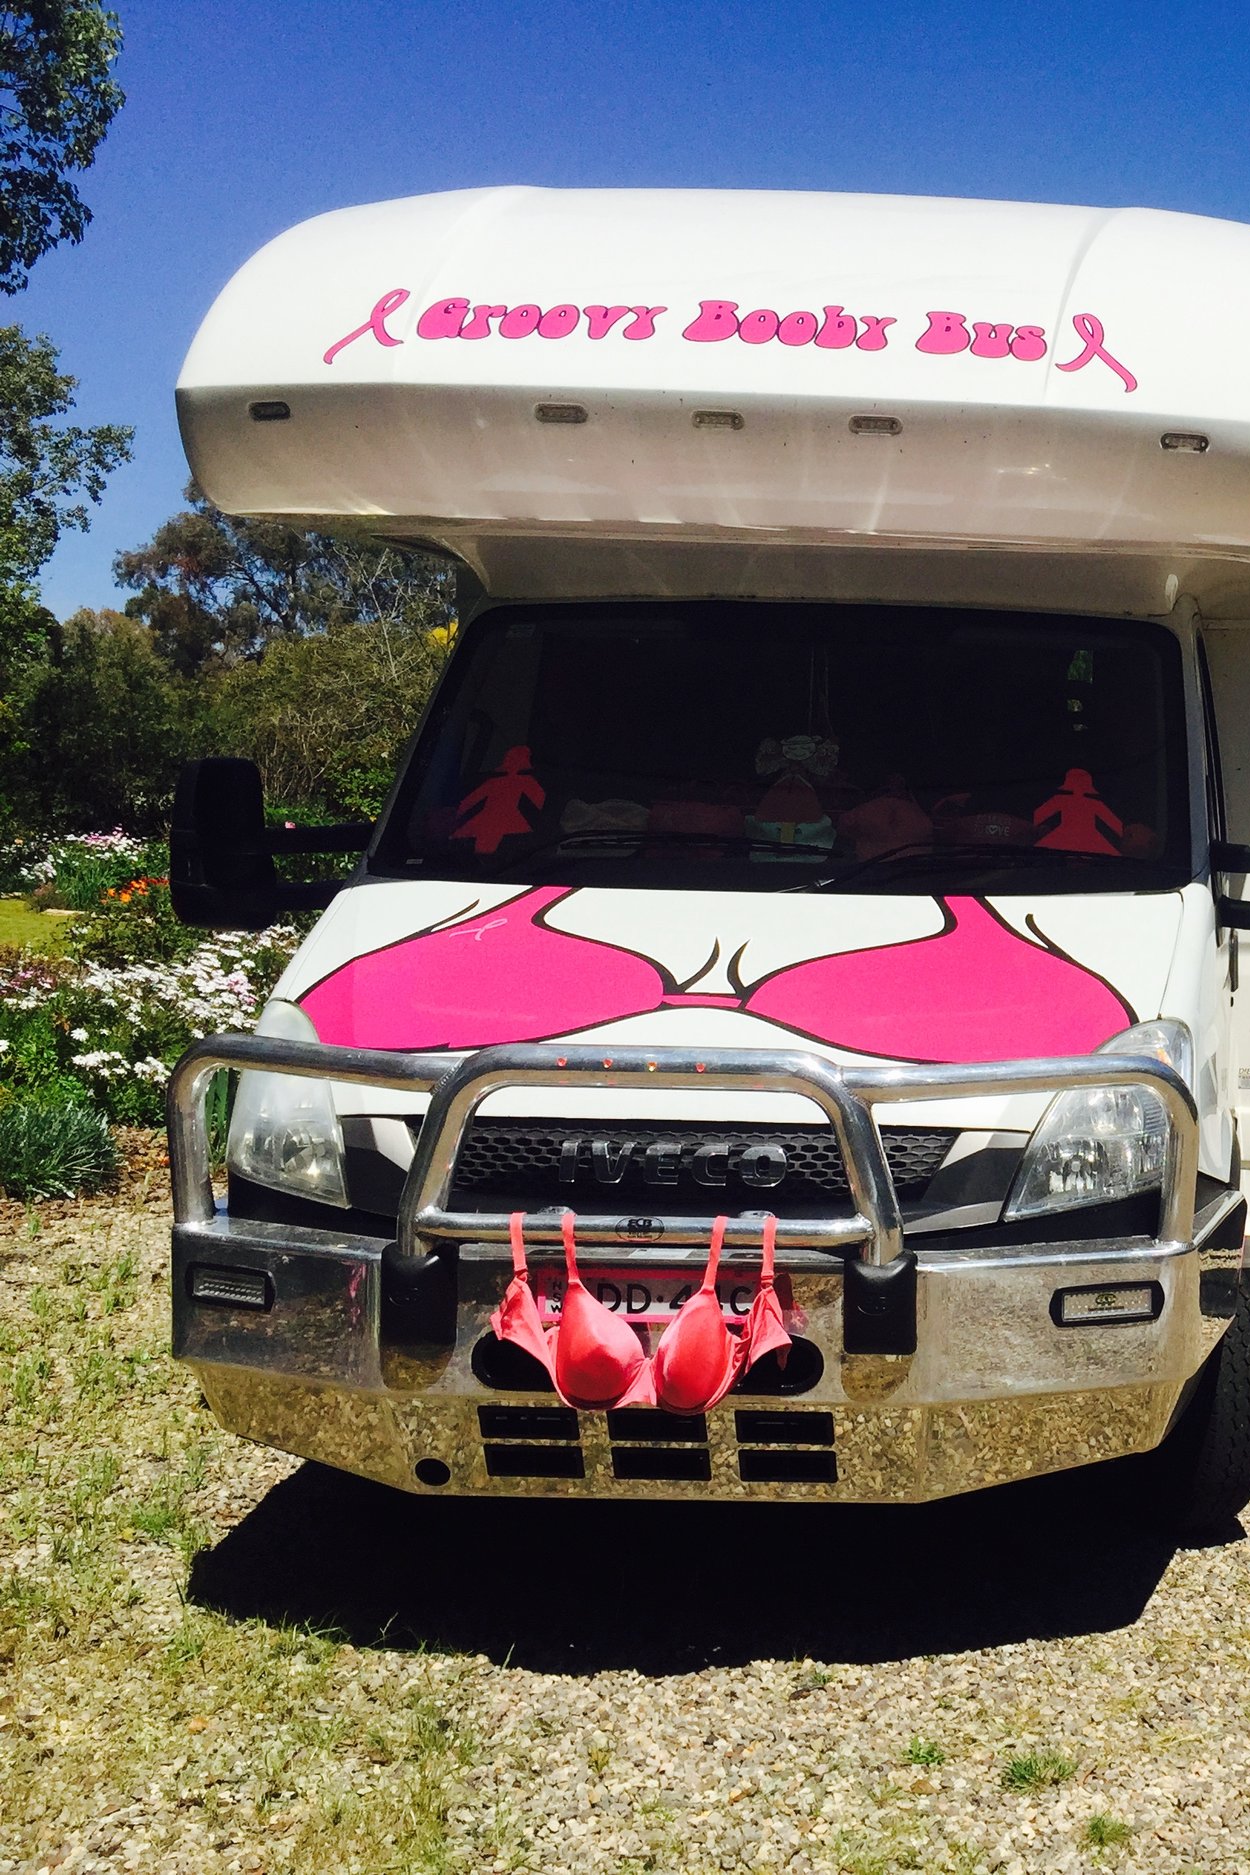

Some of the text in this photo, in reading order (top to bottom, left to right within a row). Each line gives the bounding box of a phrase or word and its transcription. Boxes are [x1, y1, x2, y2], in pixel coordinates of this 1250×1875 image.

[416, 297, 1048, 361] Groovy Booby Bus
[558, 1140, 788, 1187] IVECO
